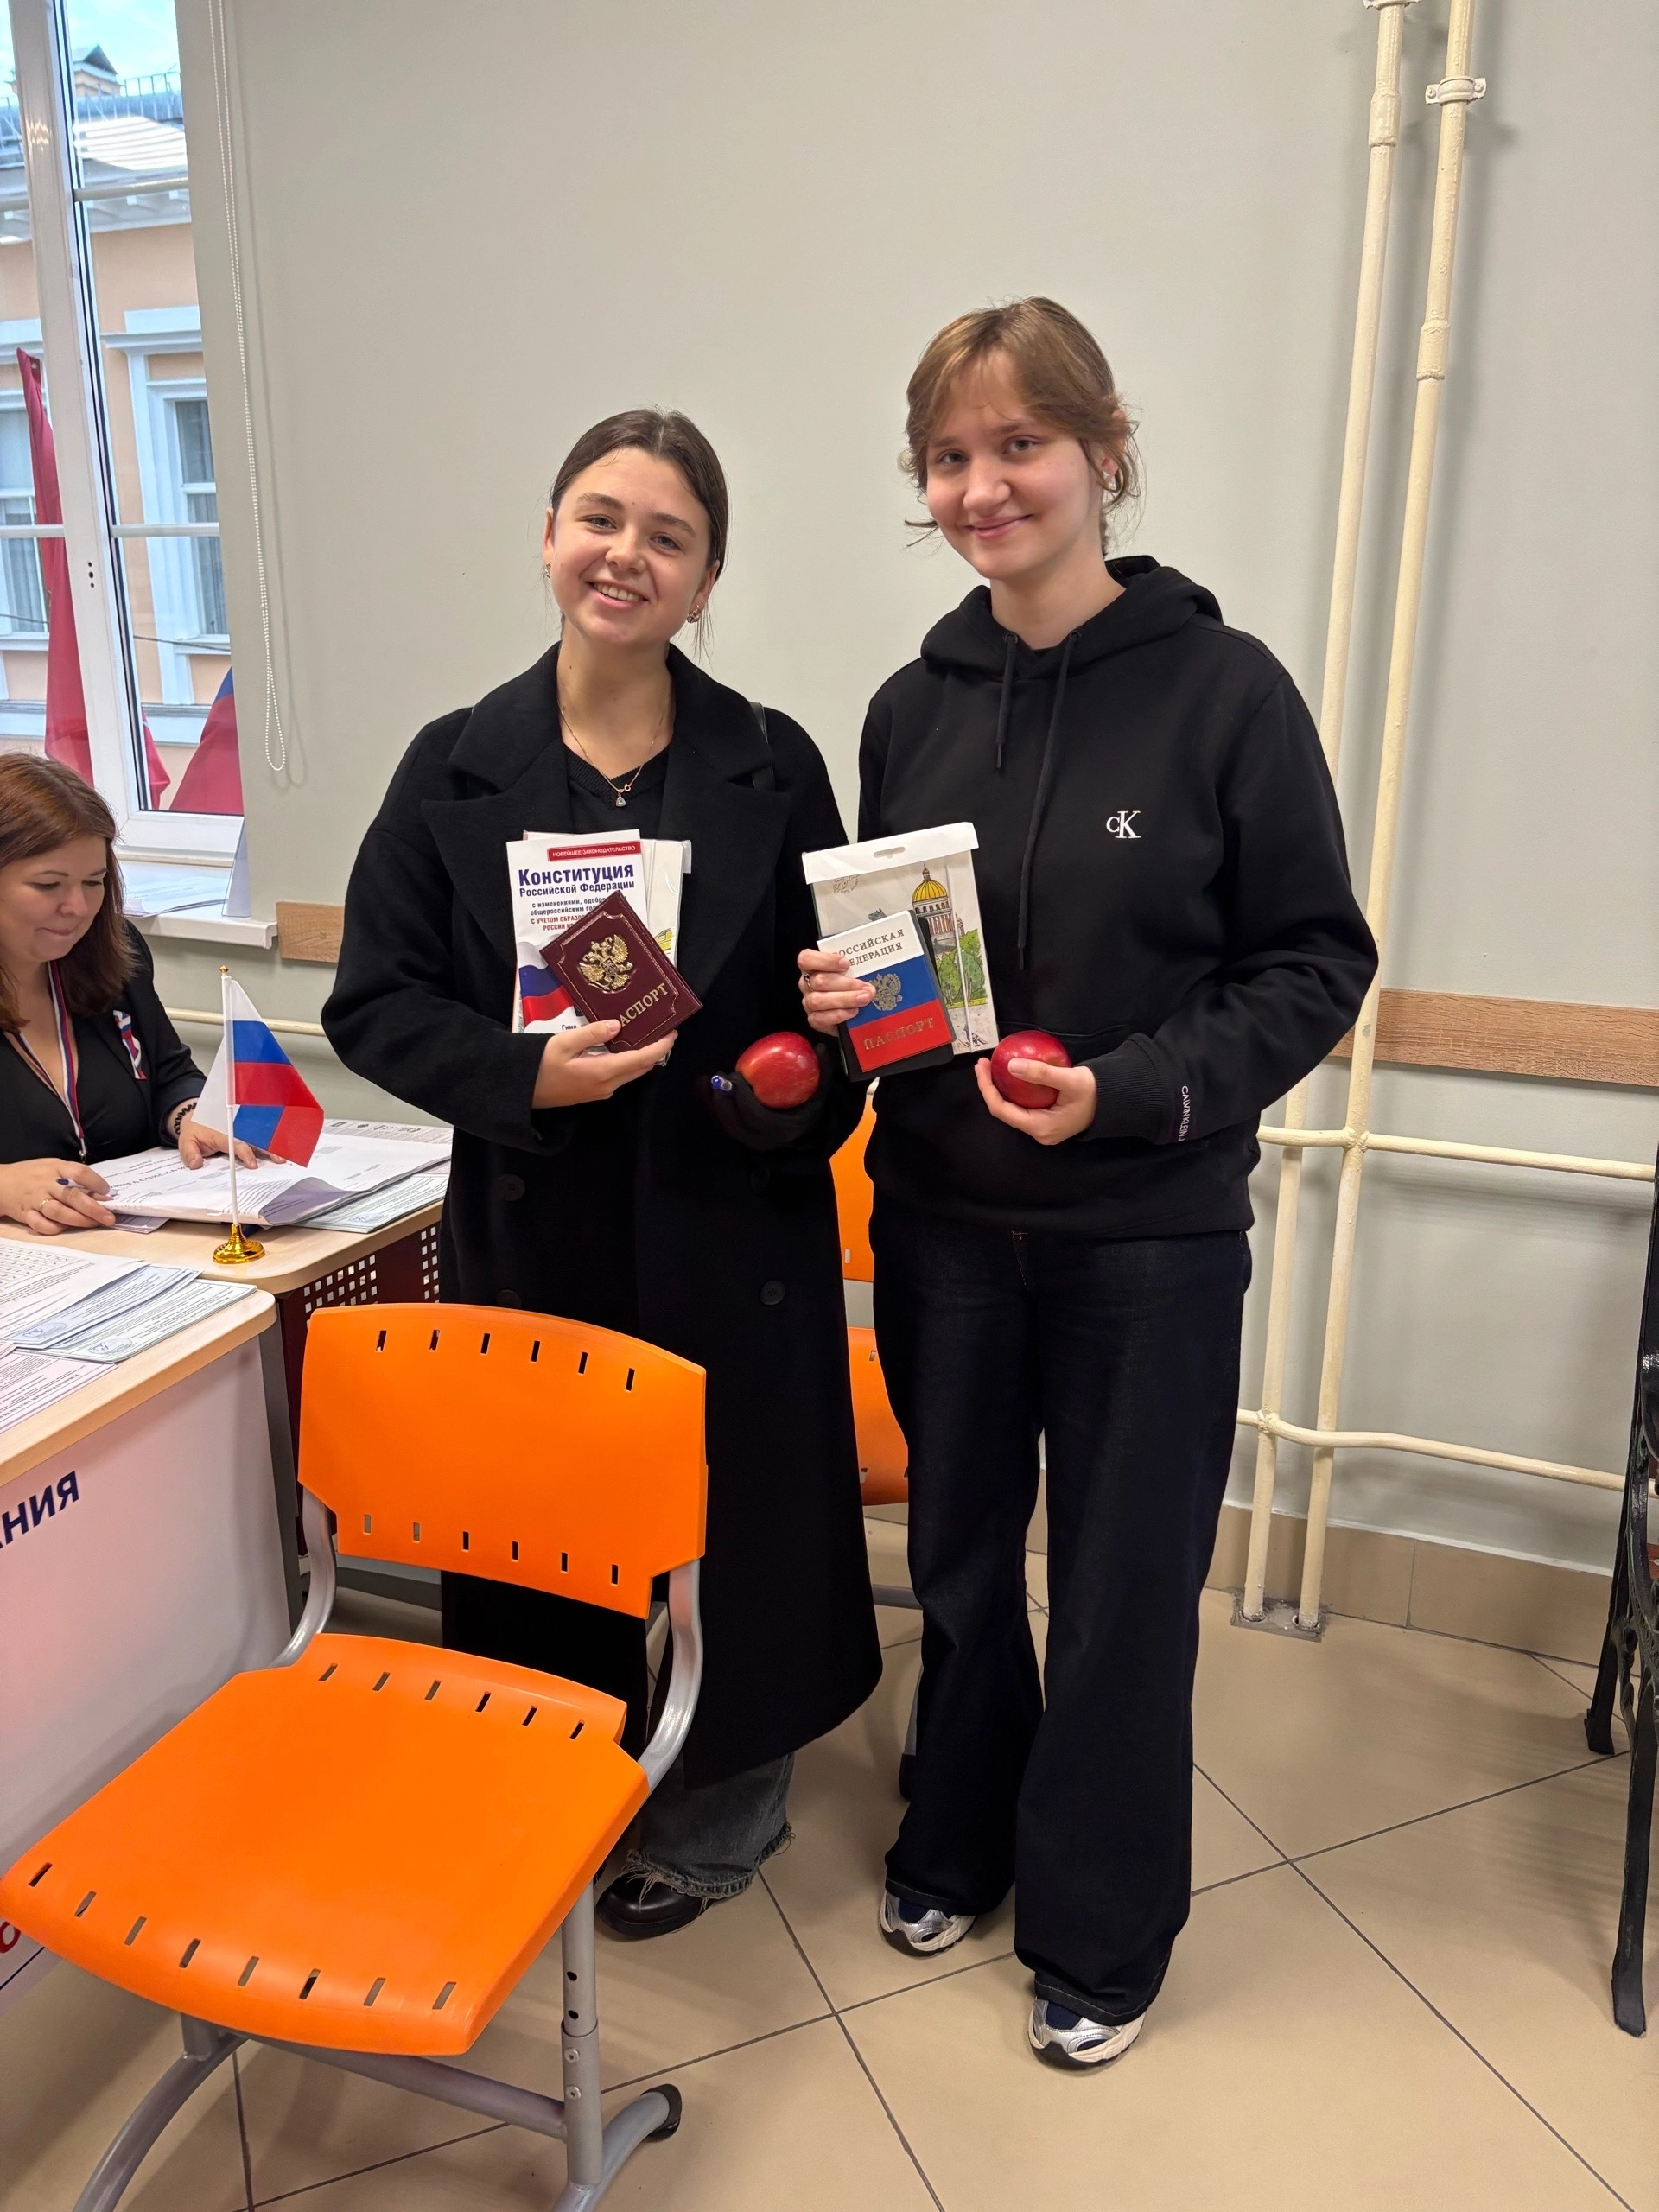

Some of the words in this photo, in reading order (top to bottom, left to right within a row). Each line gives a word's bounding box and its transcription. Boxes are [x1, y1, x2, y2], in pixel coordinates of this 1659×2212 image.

[582, 845, 636, 855] ЗАКОНОДАТЕЛЬСТВО
[518, 864, 634, 887] Конституция
[519, 885, 577, 897] Российской
[580, 880, 635, 893] Федерации
[531, 906, 584, 916] общероссийским
[849, 942, 903, 966] ЕДЕРАЦИЯ
[620, 982, 668, 1027] АСПОРТ
[864, 1017, 934, 1050] ПАСПОРТ
[1181, 1085, 1191, 1117] CALVIN
[1179, 1116, 1190, 1137] KLEIN
[0, 1471, 79, 1549] НИЯ
